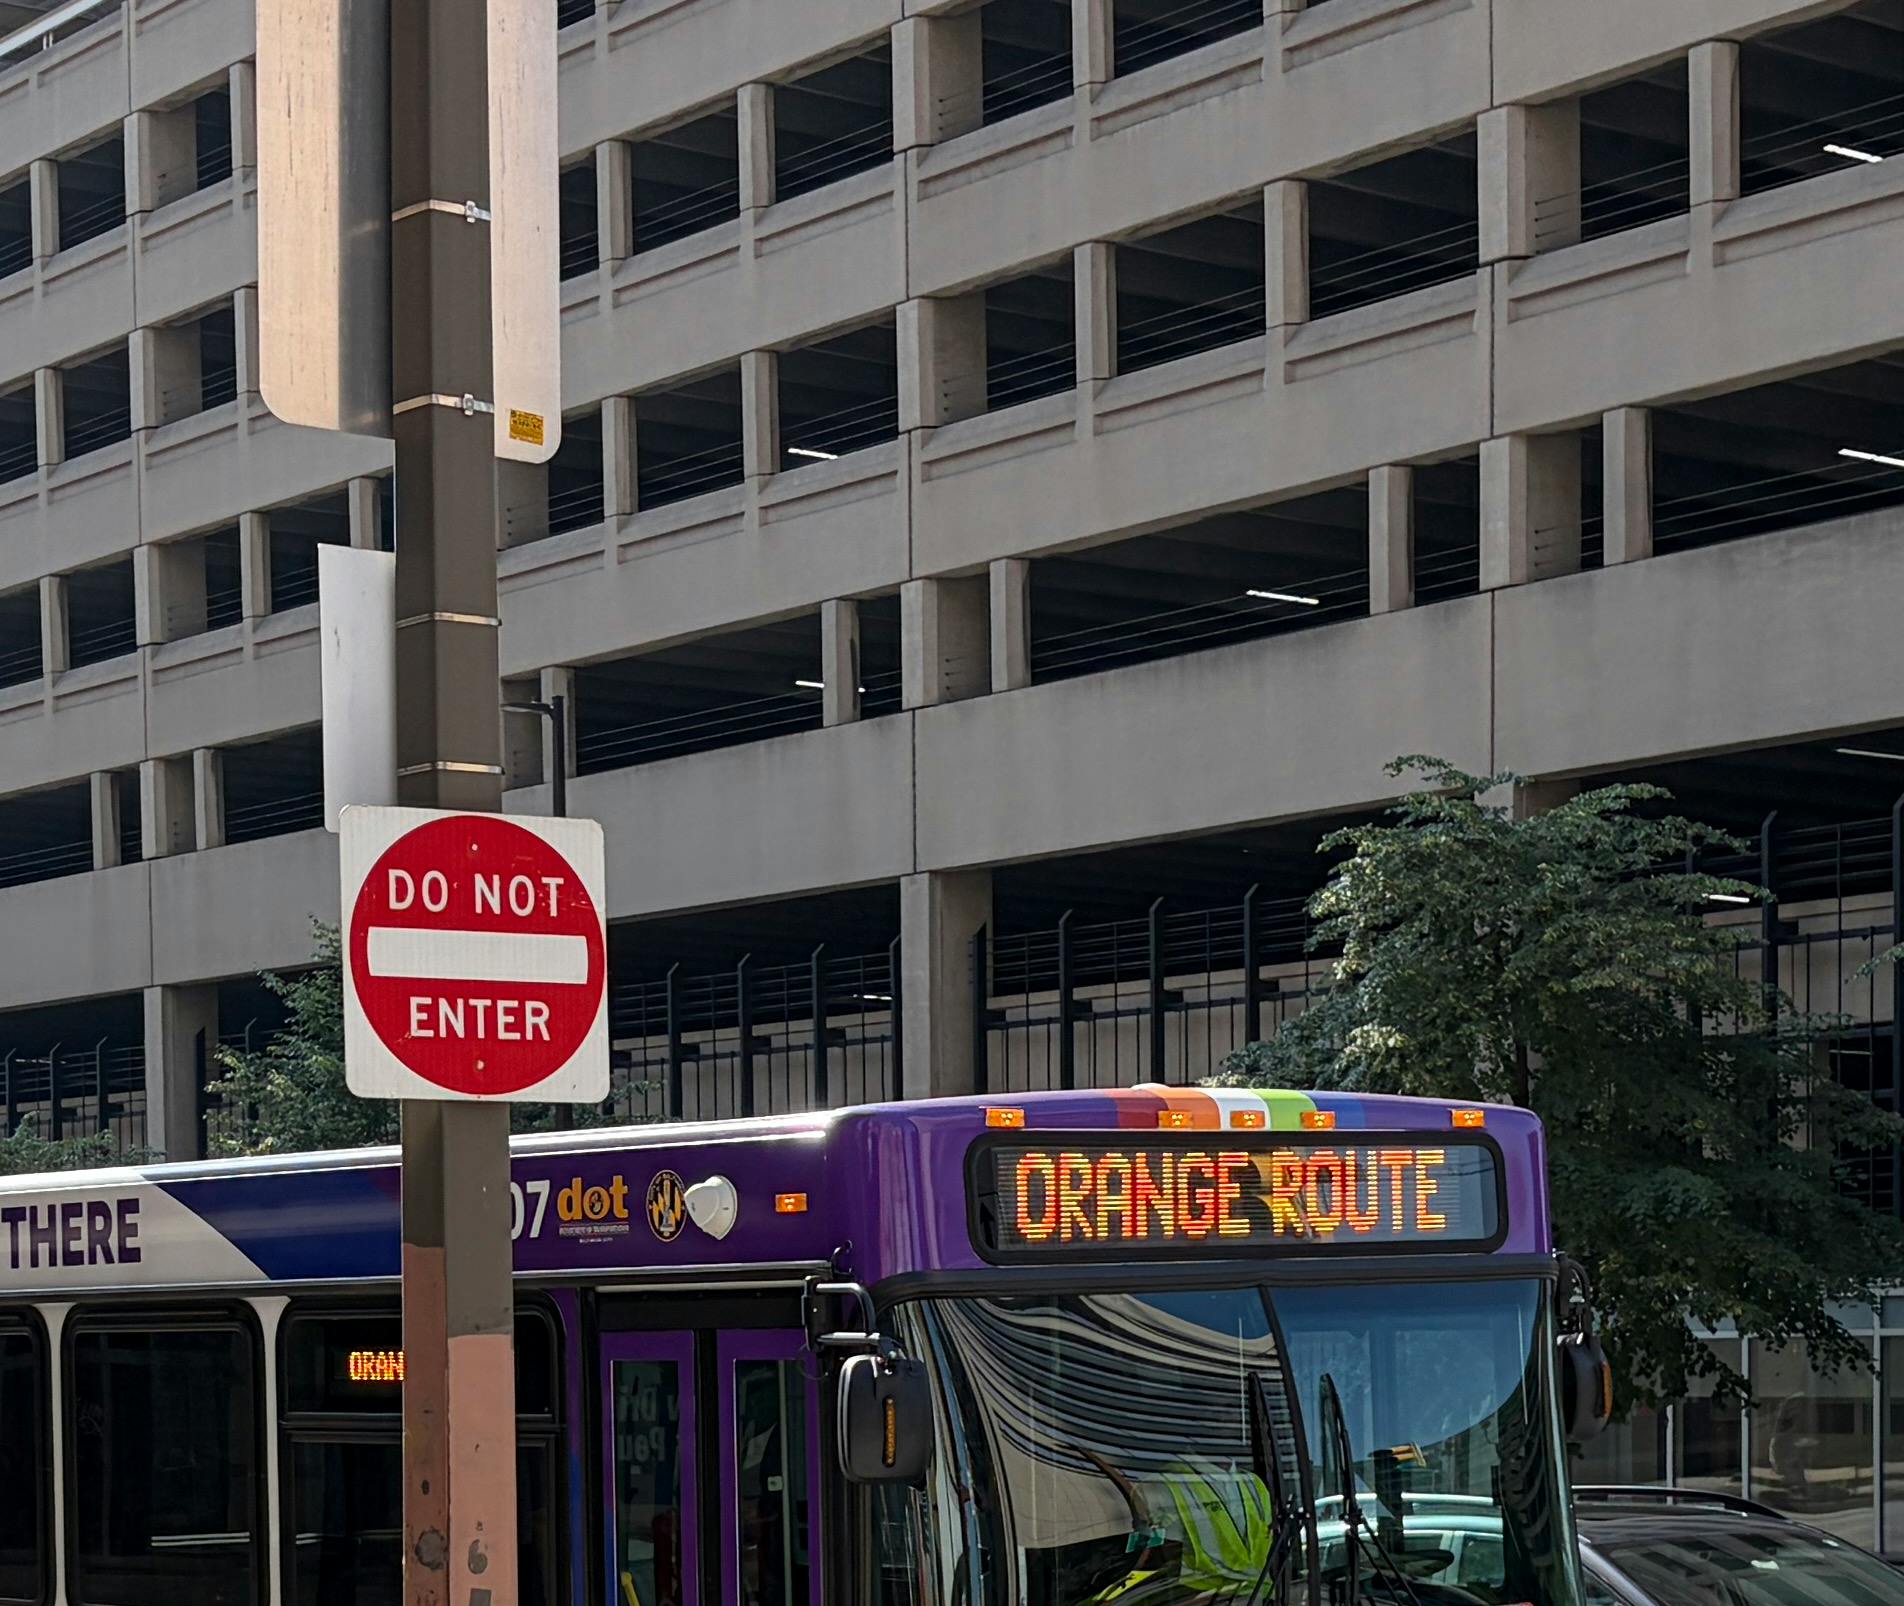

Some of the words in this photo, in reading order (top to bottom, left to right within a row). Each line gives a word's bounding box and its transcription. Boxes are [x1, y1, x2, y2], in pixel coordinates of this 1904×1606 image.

[389, 868, 449, 912] DO
[474, 873, 565, 917] NOT
[410, 996, 551, 1041] ENTER
[557, 1175, 629, 1221] dot
[1016, 1152, 1251, 1241] ORANGE
[1272, 1149, 1446, 1239] ROUTE
[1, 1198, 141, 1269] THERE
